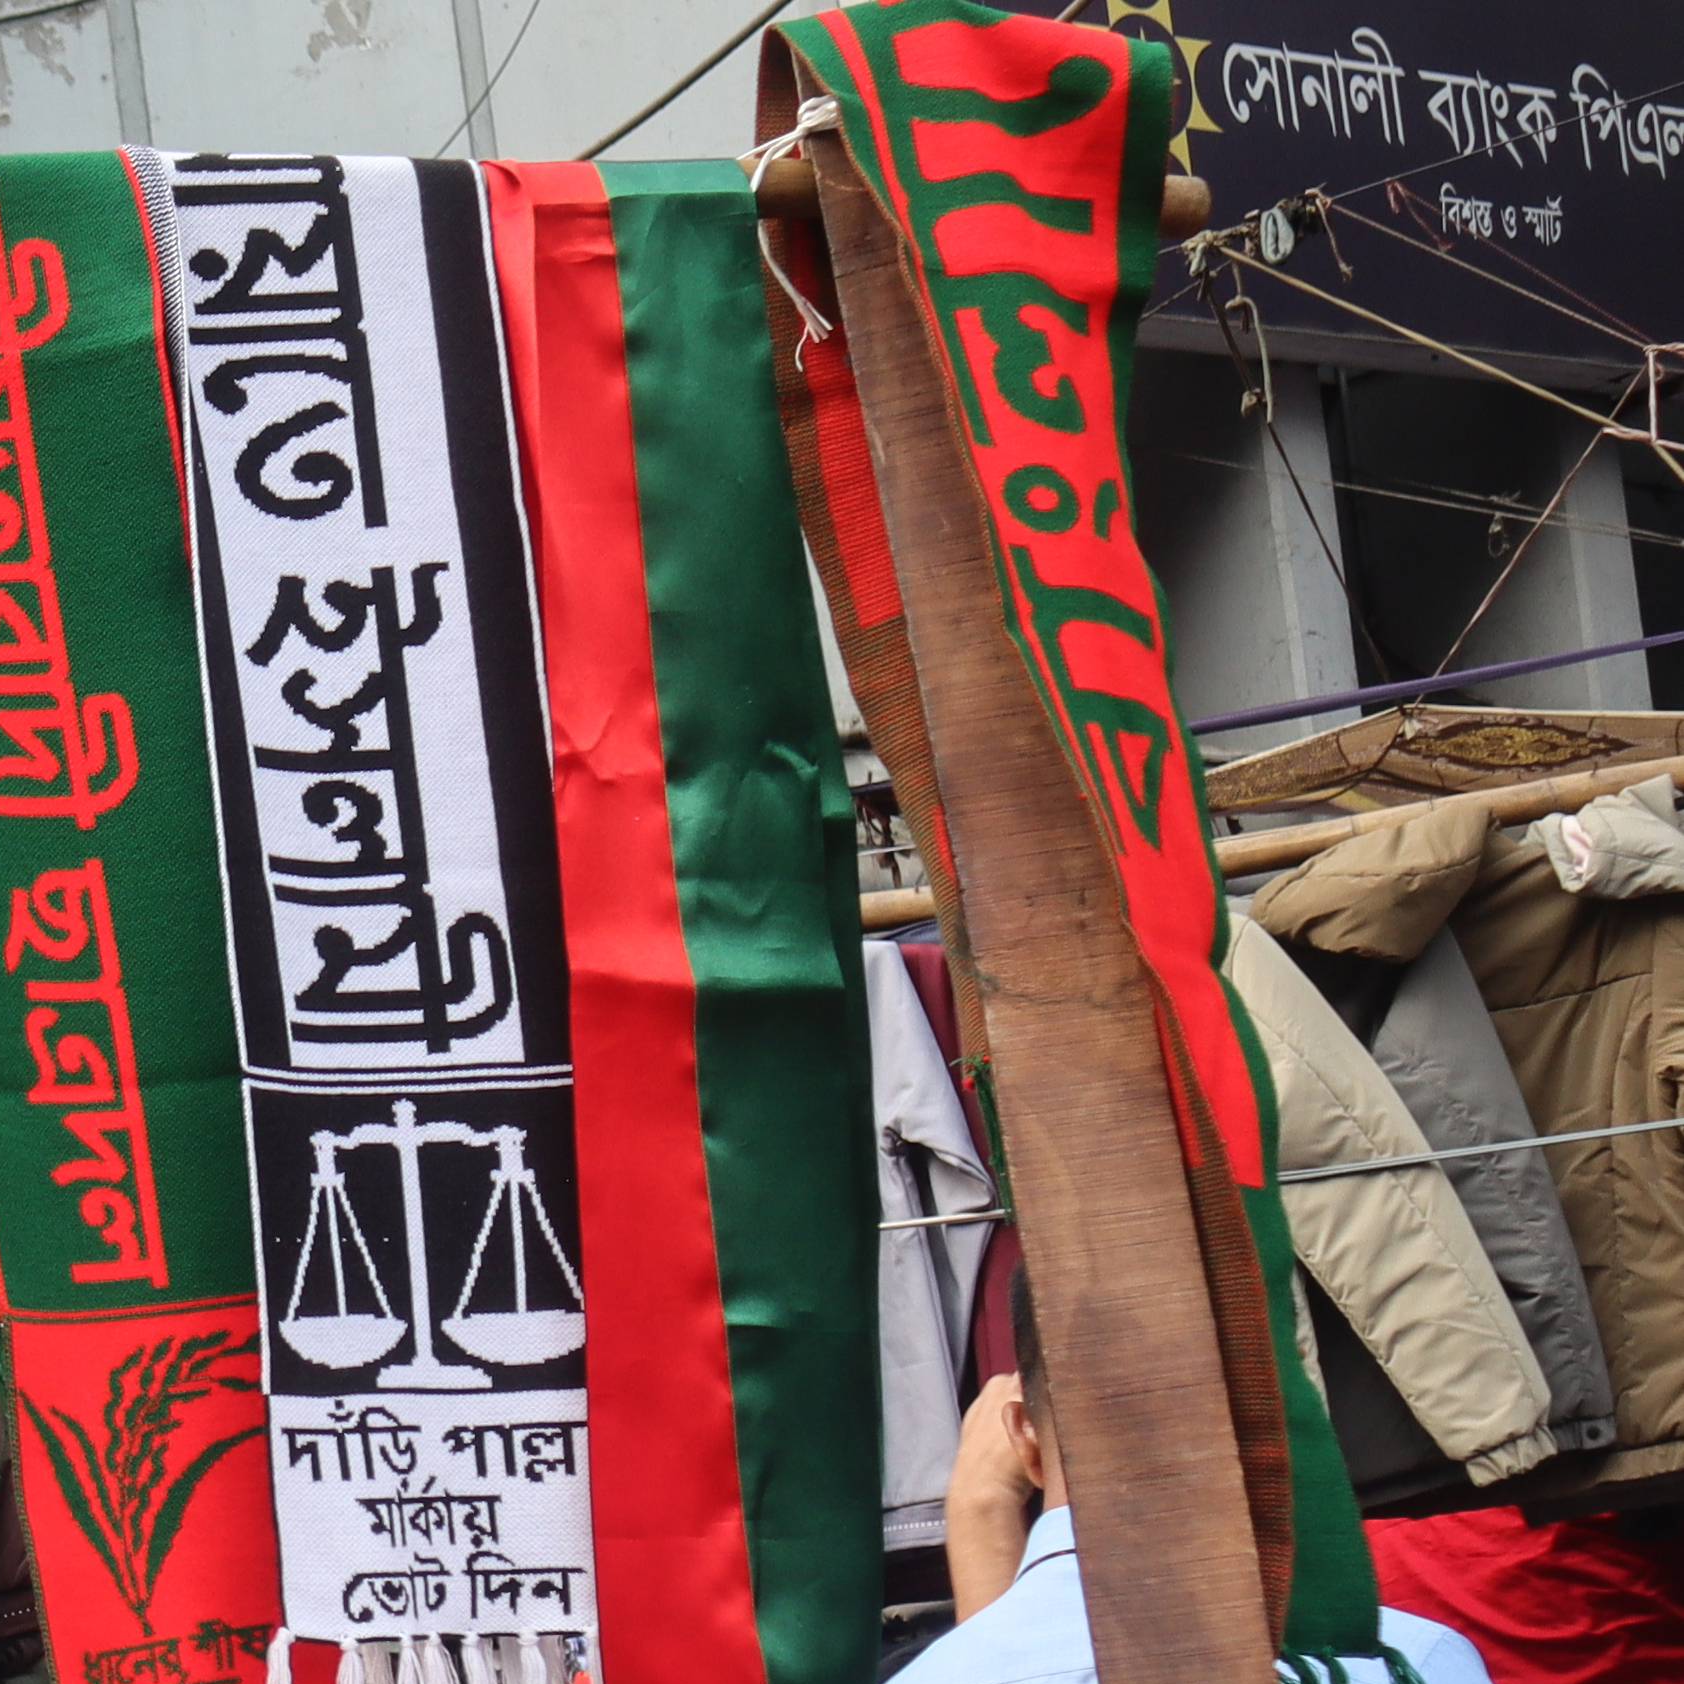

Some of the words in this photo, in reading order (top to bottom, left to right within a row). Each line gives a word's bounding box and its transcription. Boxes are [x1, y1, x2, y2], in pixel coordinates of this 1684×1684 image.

[1222, 26, 1406, 148] সোনালী
[1418, 69, 1557, 168] ব্যাংক
[1499, 209, 1519, 240] ও
[244, 560, 516, 1055] ইসলামী
[354, 1475, 503, 1549] মার্কায়
[341, 1552, 453, 1624] ভোট
[461, 1550, 588, 1620] দিন
